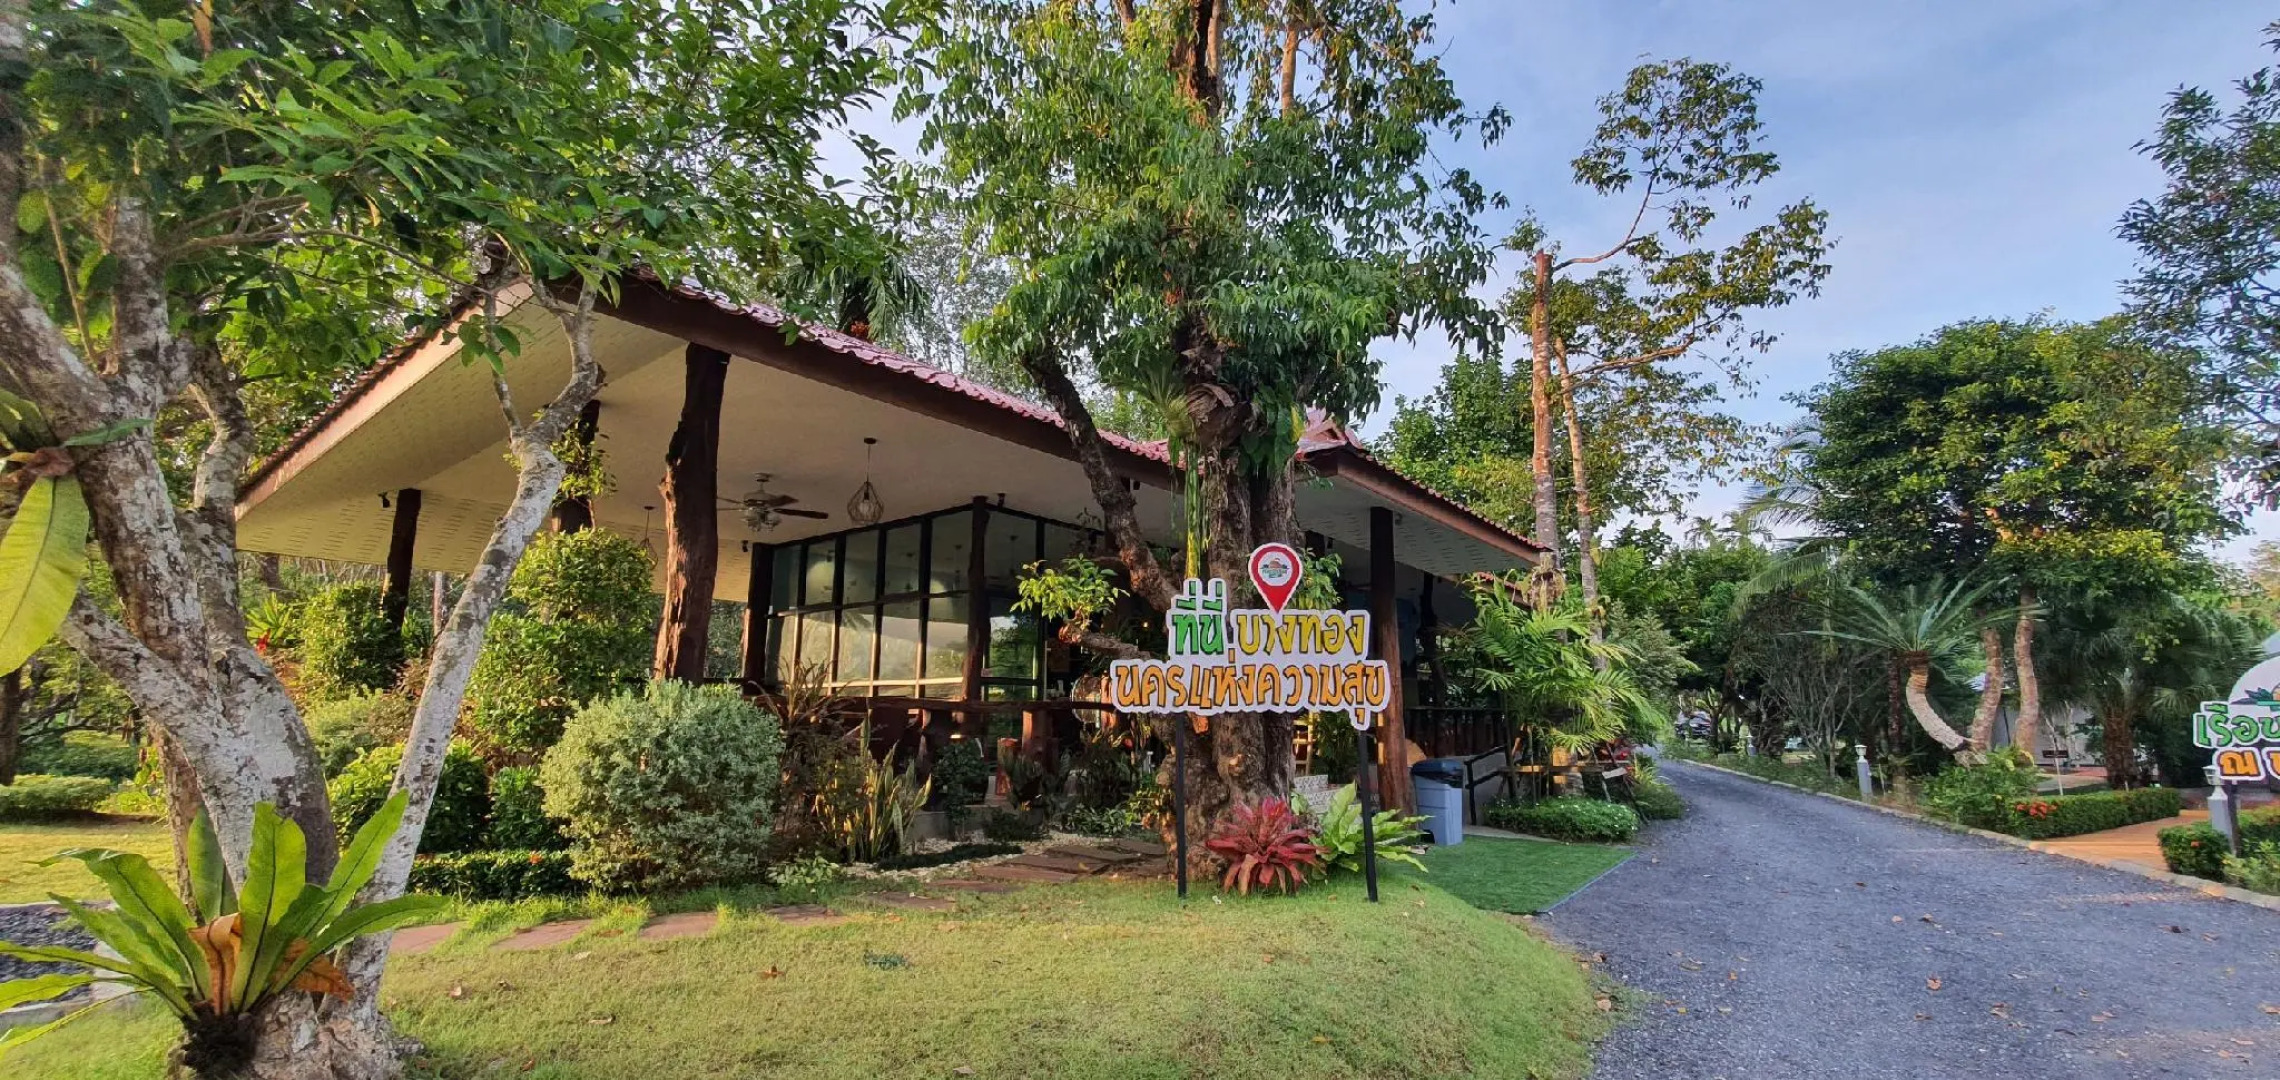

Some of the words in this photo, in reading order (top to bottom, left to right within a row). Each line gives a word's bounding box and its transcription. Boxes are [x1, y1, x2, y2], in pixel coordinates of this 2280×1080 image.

[1171, 580, 1224, 656] ที่นี่
[1236, 613, 1365, 657] บางทอง
[1115, 647, 1386, 725] นครแห่งความสุข
